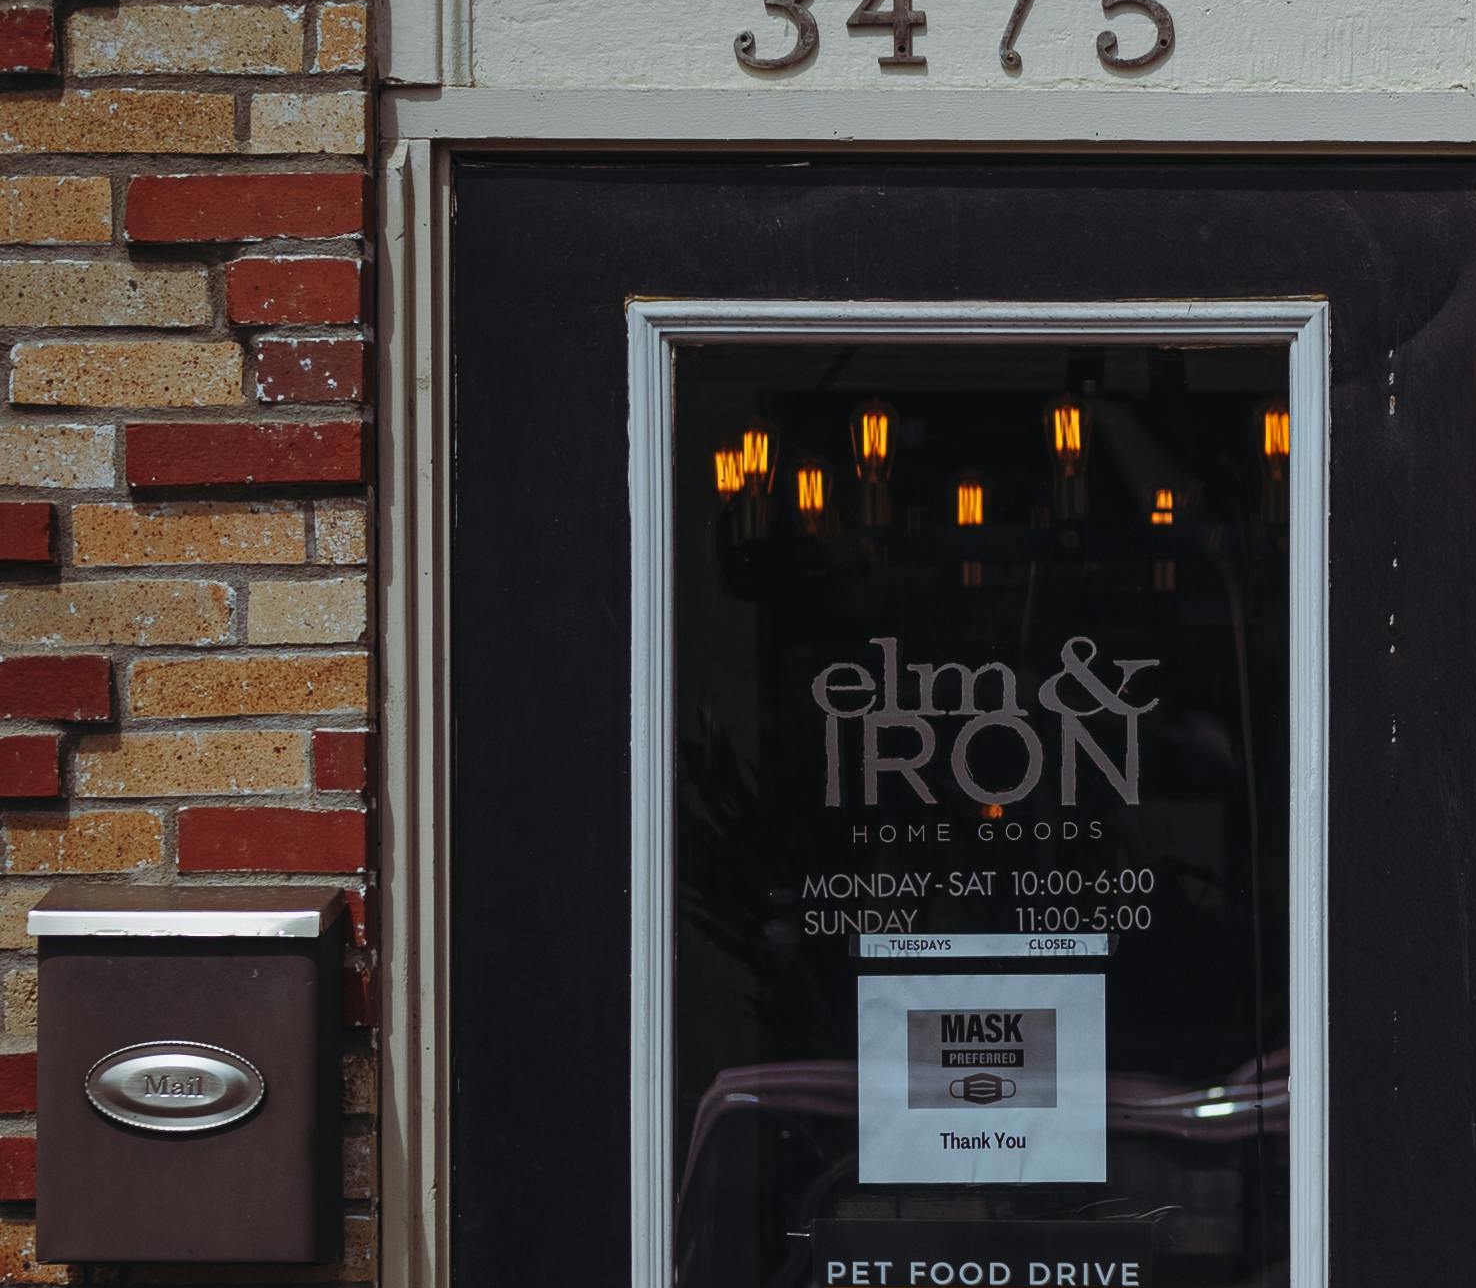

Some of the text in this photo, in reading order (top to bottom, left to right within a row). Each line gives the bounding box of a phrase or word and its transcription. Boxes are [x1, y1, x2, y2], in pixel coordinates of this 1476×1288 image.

[825, 713, 1139, 806] IRON
[854, 821, 1103, 843] HOME GOODS
[1012, 869, 1154, 895] 10:00-6:00
[804, 905, 1152, 935] SUNDAY 11:00-5:00
[889, 938, 1076, 951] TUESDAYS CLOSED
[941, 1014, 1023, 1043] MASK
[950, 1053, 1016, 1064] PREFERRED
[143, 1075, 205, 1098] Mail
[940, 1132, 1026, 1149] Thank You
[827, 1262, 1140, 1286] PET FOOD DRIVE
